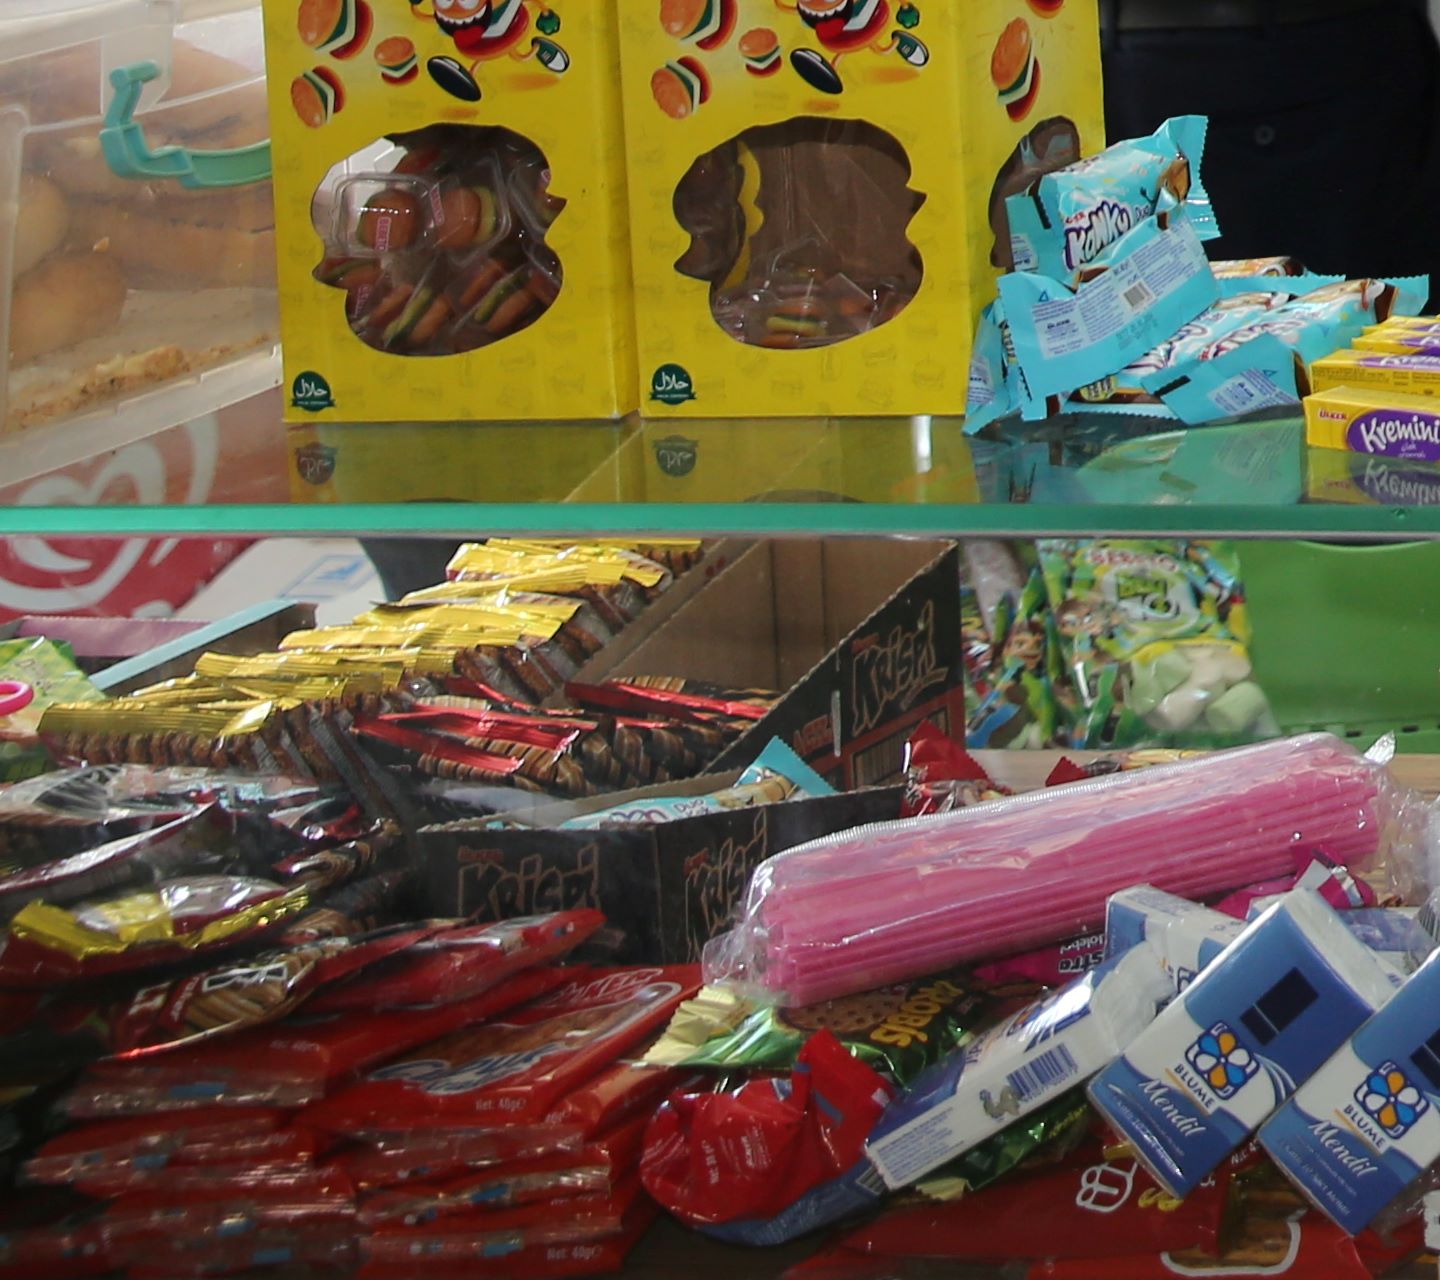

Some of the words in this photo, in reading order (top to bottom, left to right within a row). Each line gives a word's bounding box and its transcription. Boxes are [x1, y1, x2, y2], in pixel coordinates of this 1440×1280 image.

[1318, 406, 1348, 421] ÜLKER
[1133, 1073, 1212, 1139] Mendil
[1170, 1061, 1217, 1112] BLUME
[1304, 1117, 1379, 1180] Mendil
[1341, 1103, 1387, 1151] BLUME
